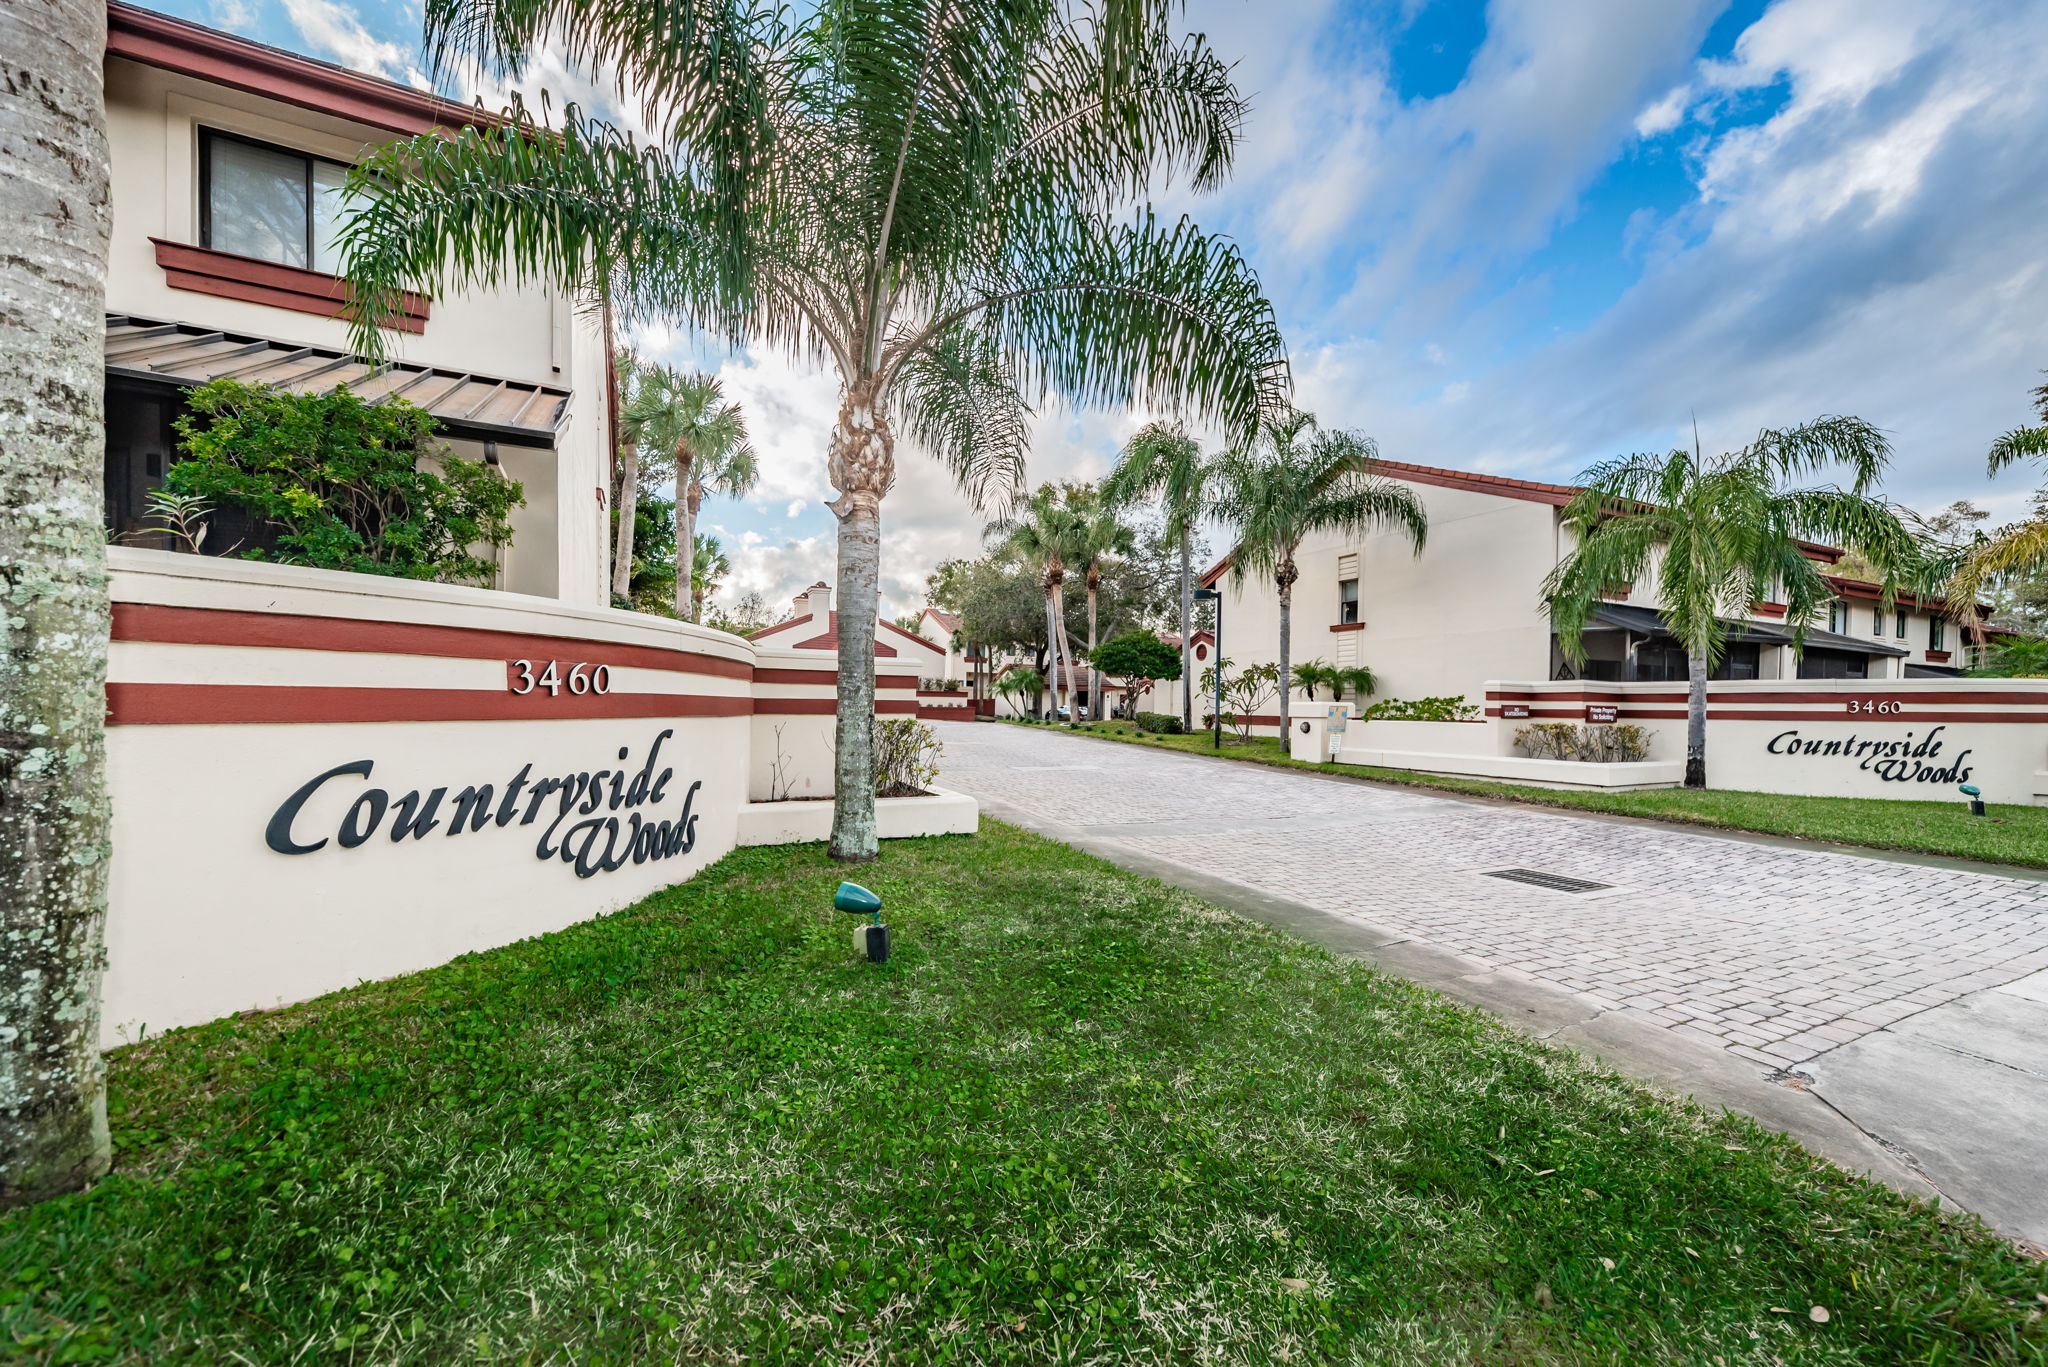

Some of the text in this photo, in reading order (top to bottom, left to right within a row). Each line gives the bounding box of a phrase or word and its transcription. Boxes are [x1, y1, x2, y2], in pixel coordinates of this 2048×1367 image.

[511, 659, 610, 697] 3460
[1847, 700, 1902, 714] 3460
[1767, 725, 1946, 770] Countryside
[1874, 749, 1974, 784] Woods
[265, 729, 674, 860] Countryside
[560, 780, 702, 879] Woods
